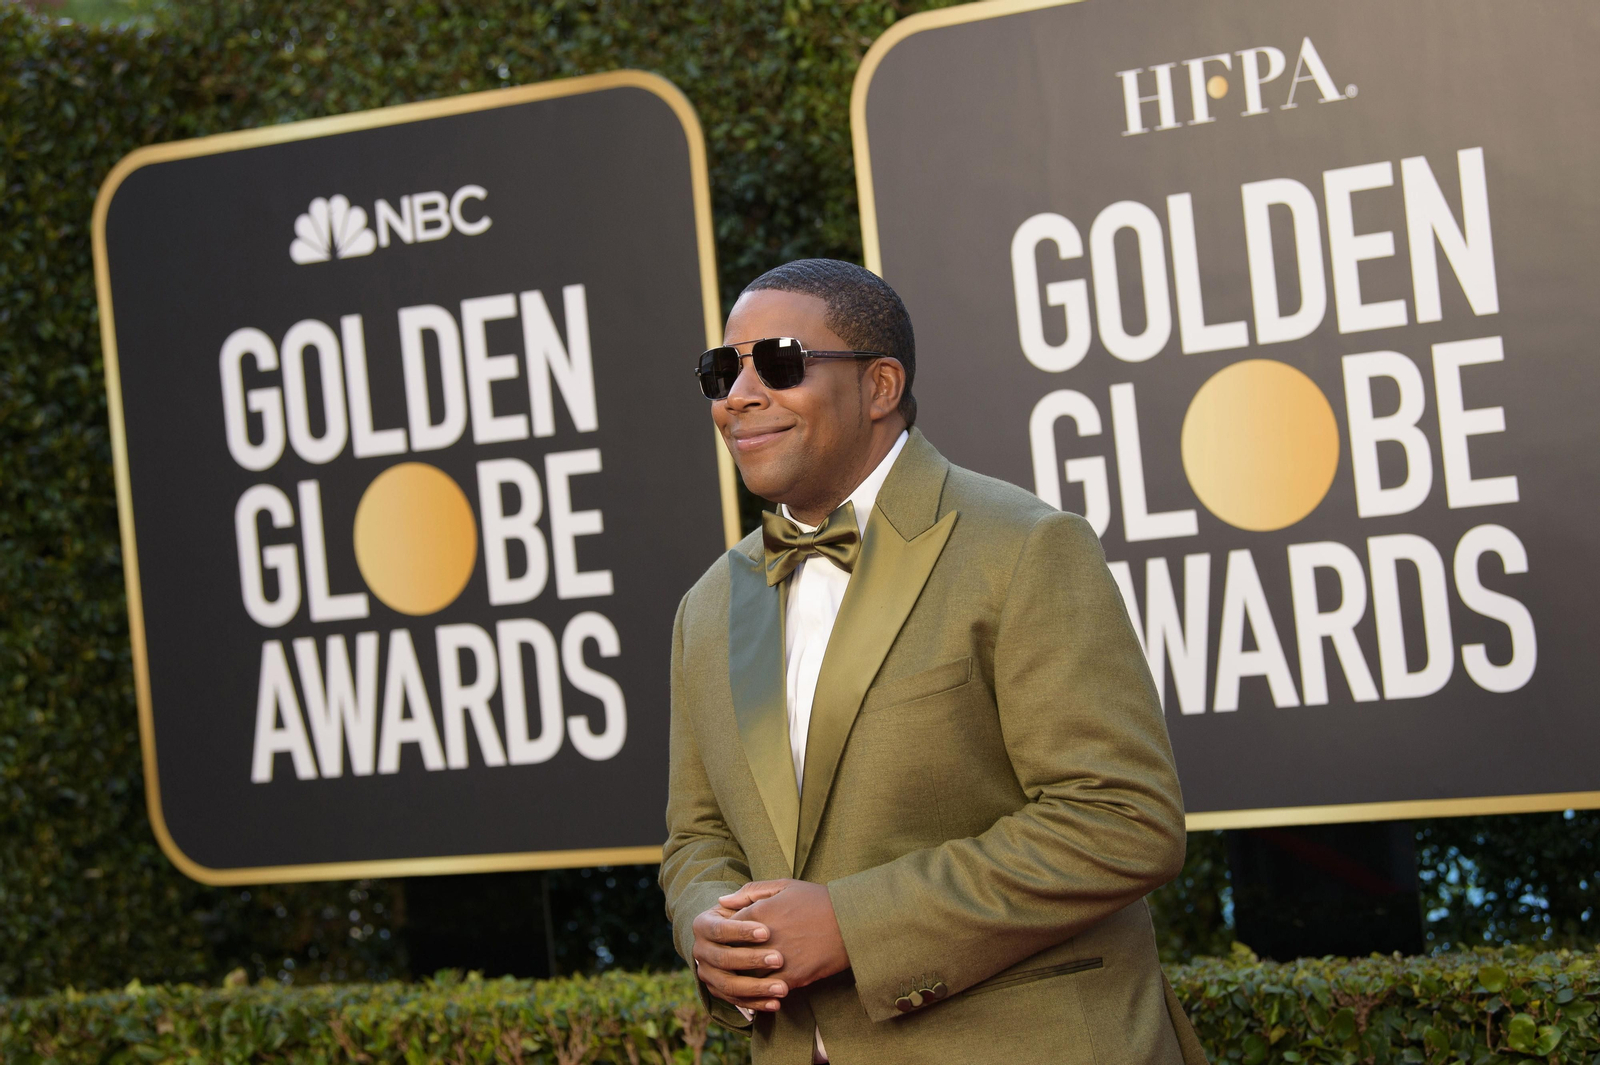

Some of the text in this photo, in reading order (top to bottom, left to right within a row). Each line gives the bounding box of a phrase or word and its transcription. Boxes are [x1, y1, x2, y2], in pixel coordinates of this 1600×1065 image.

[374, 184, 493, 249] NBC
[1010, 146, 1500, 373] GOLDEN
[219, 284, 599, 471] GOLDEN
[1029, 335, 1520, 543] GLOBE
[234, 448, 614, 628] GLOBE
[1105, 524, 1538, 715] WARDS
[250, 611, 627, 785] AWARDS
